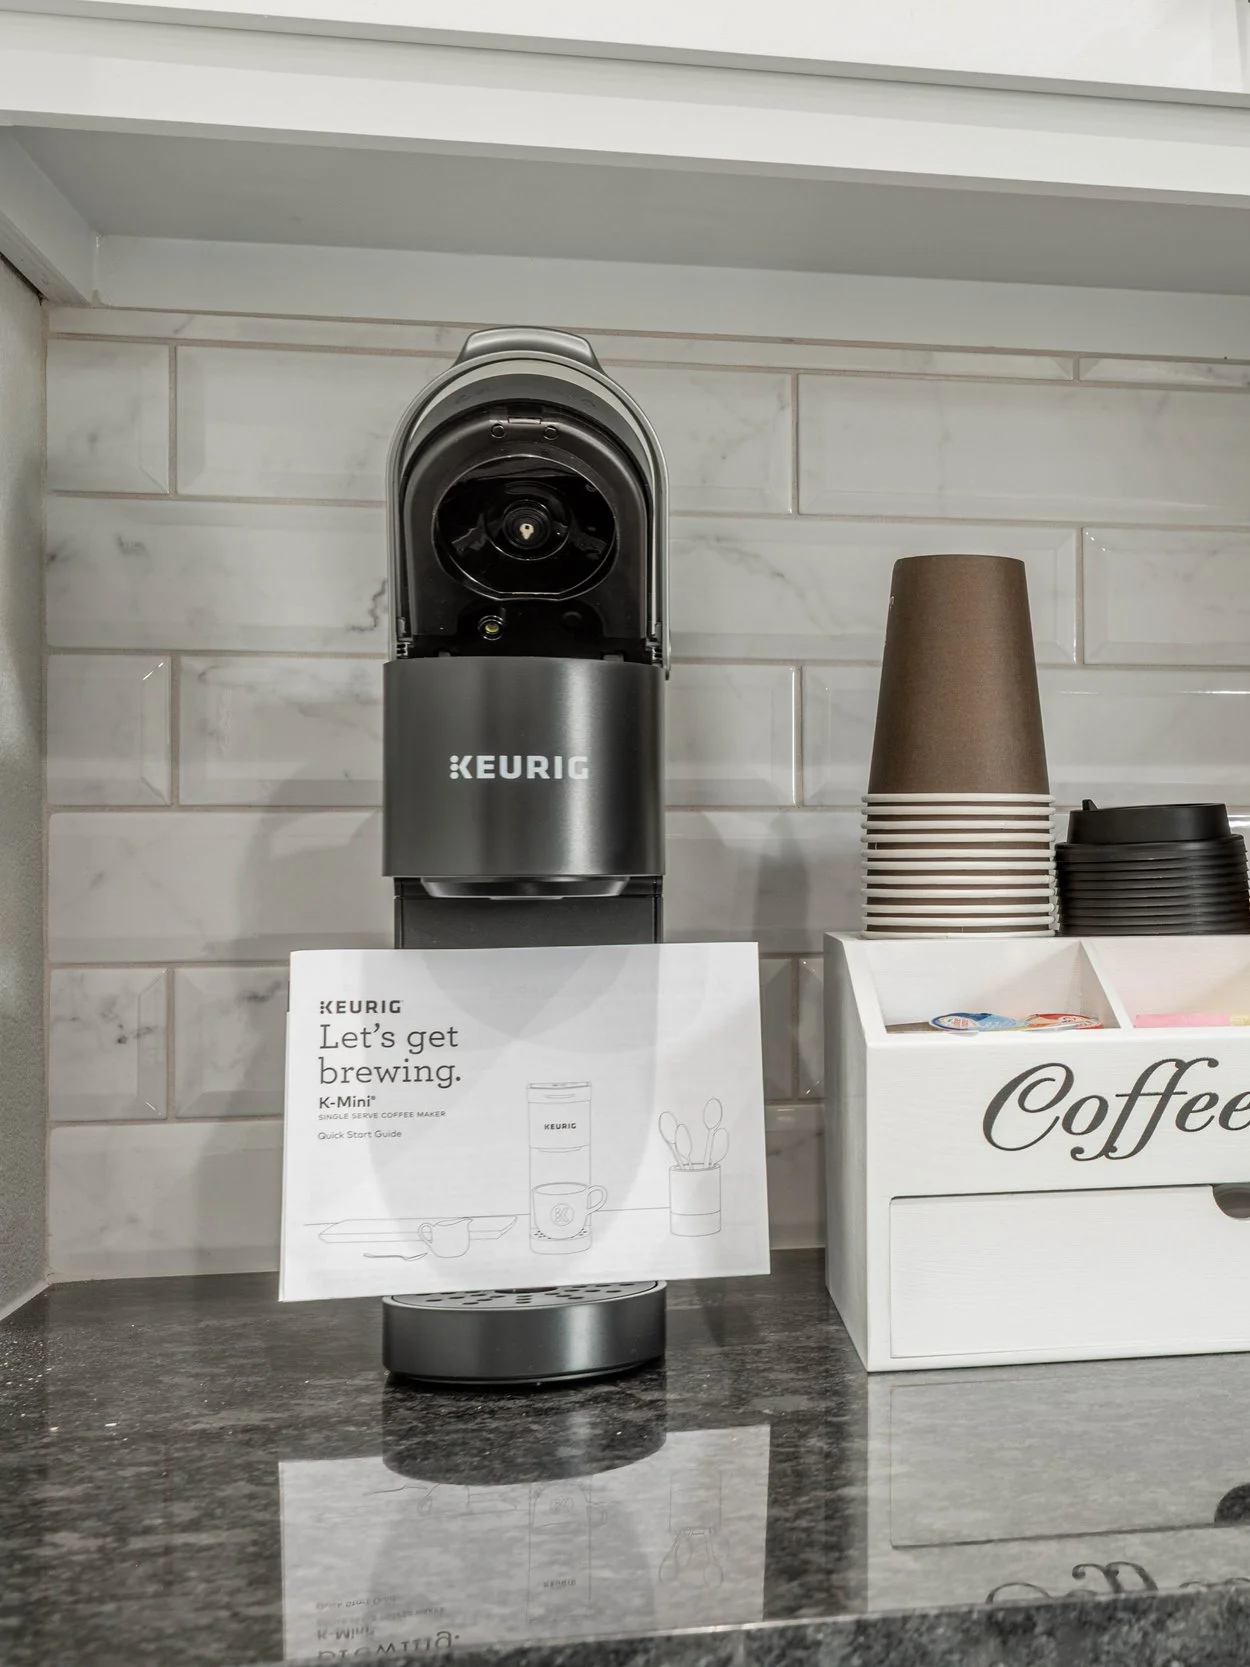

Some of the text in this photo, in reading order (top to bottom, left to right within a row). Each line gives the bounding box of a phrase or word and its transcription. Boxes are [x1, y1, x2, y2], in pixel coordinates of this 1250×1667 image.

[449, 755, 589, 780] KEURIG
[320, 1000, 401, 1014] KEURIG
[320, 1023, 459, 1055] Let’s get
[318, 1056, 461, 1089] brewing.
[318, 1110, 446, 1121] SINGLE SERVE COFFEE MAKER
[544, 1122, 577, 1130] KEURIG
[317, 1129, 402, 1140] Quick Start Guide
